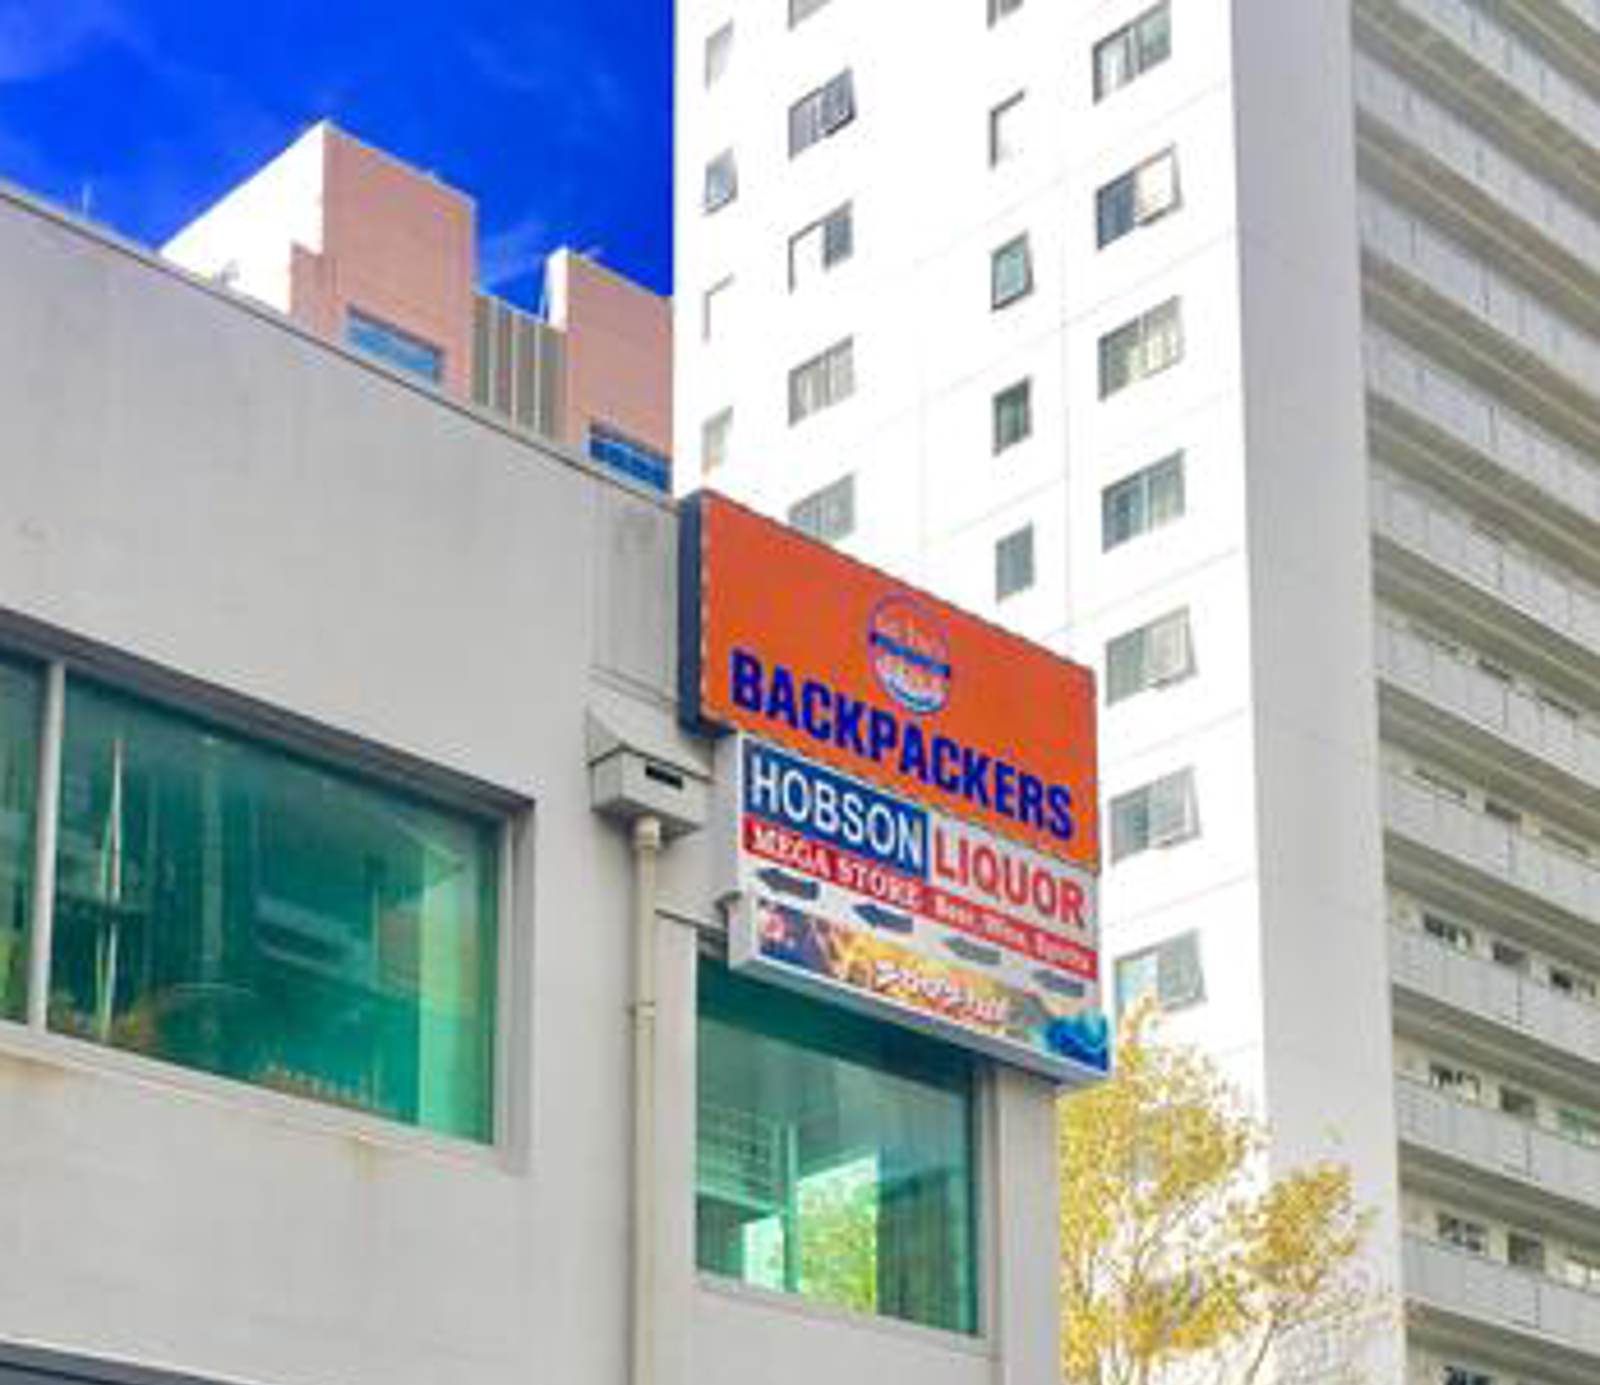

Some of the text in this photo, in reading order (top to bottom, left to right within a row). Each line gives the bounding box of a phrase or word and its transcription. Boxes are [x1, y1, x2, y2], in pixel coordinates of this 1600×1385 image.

[730, 645, 1073, 841] BACKPACKERS
[752, 752, 1086, 928] HOBSON LIQUOR
[753, 822, 832, 878] MEGA
